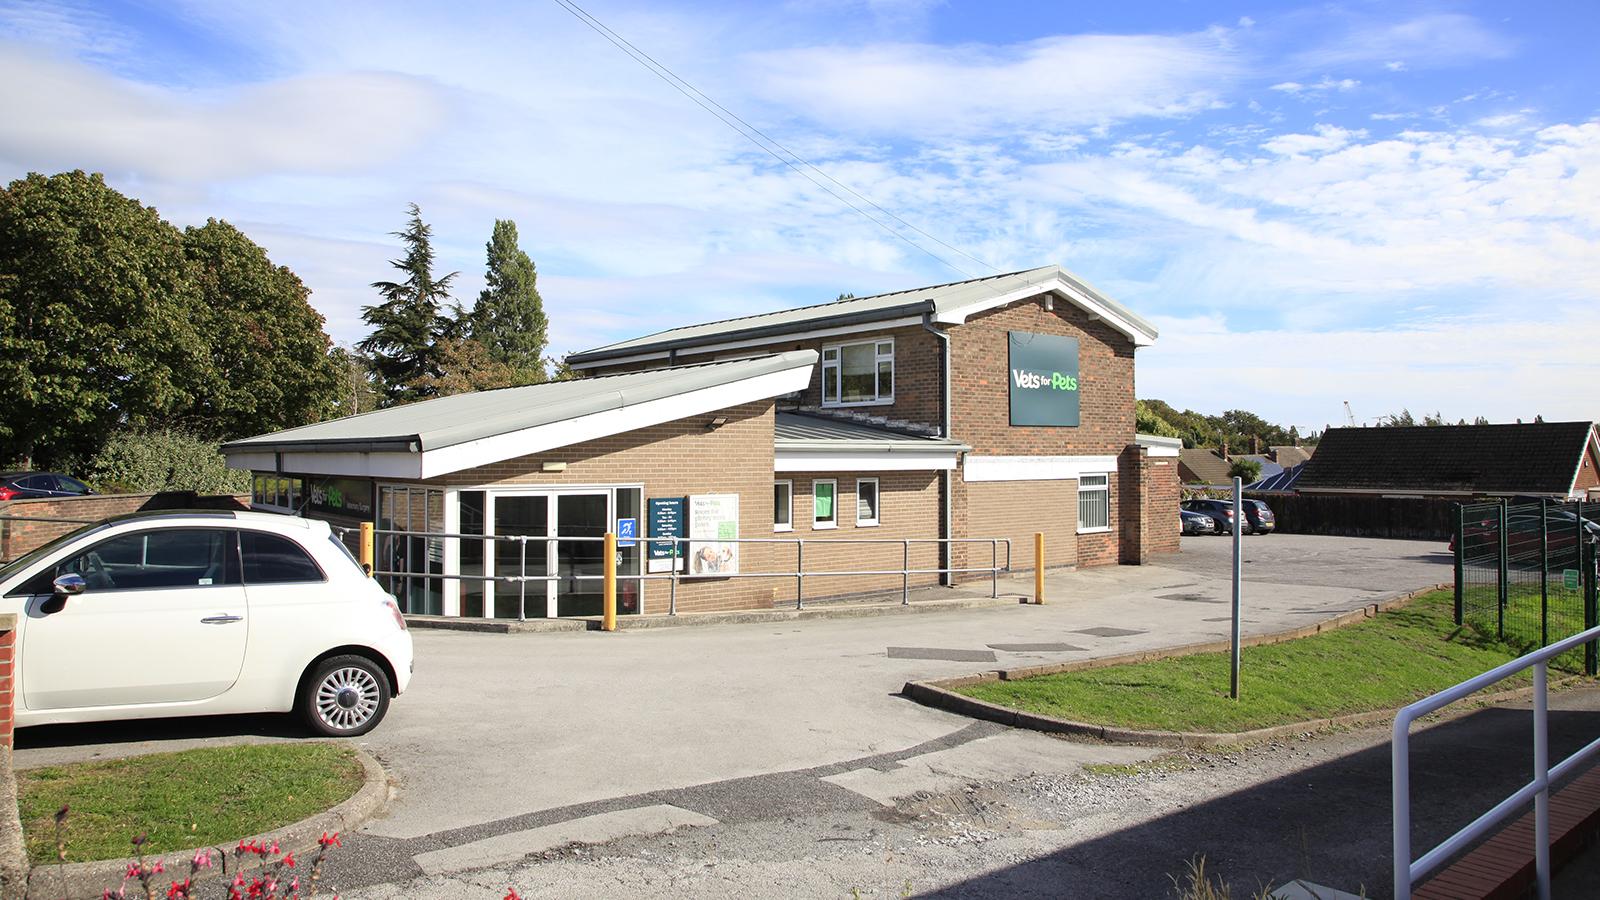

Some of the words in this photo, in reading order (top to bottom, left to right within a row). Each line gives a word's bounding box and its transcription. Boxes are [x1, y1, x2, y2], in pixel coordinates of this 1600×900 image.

[1013, 369, 1040, 389] Vets
[1041, 375, 1050, 386] for
[1052, 372, 1077, 391] Pets
[310, 484, 323, 505] Vets
[328, 486, 342, 508] Pets
